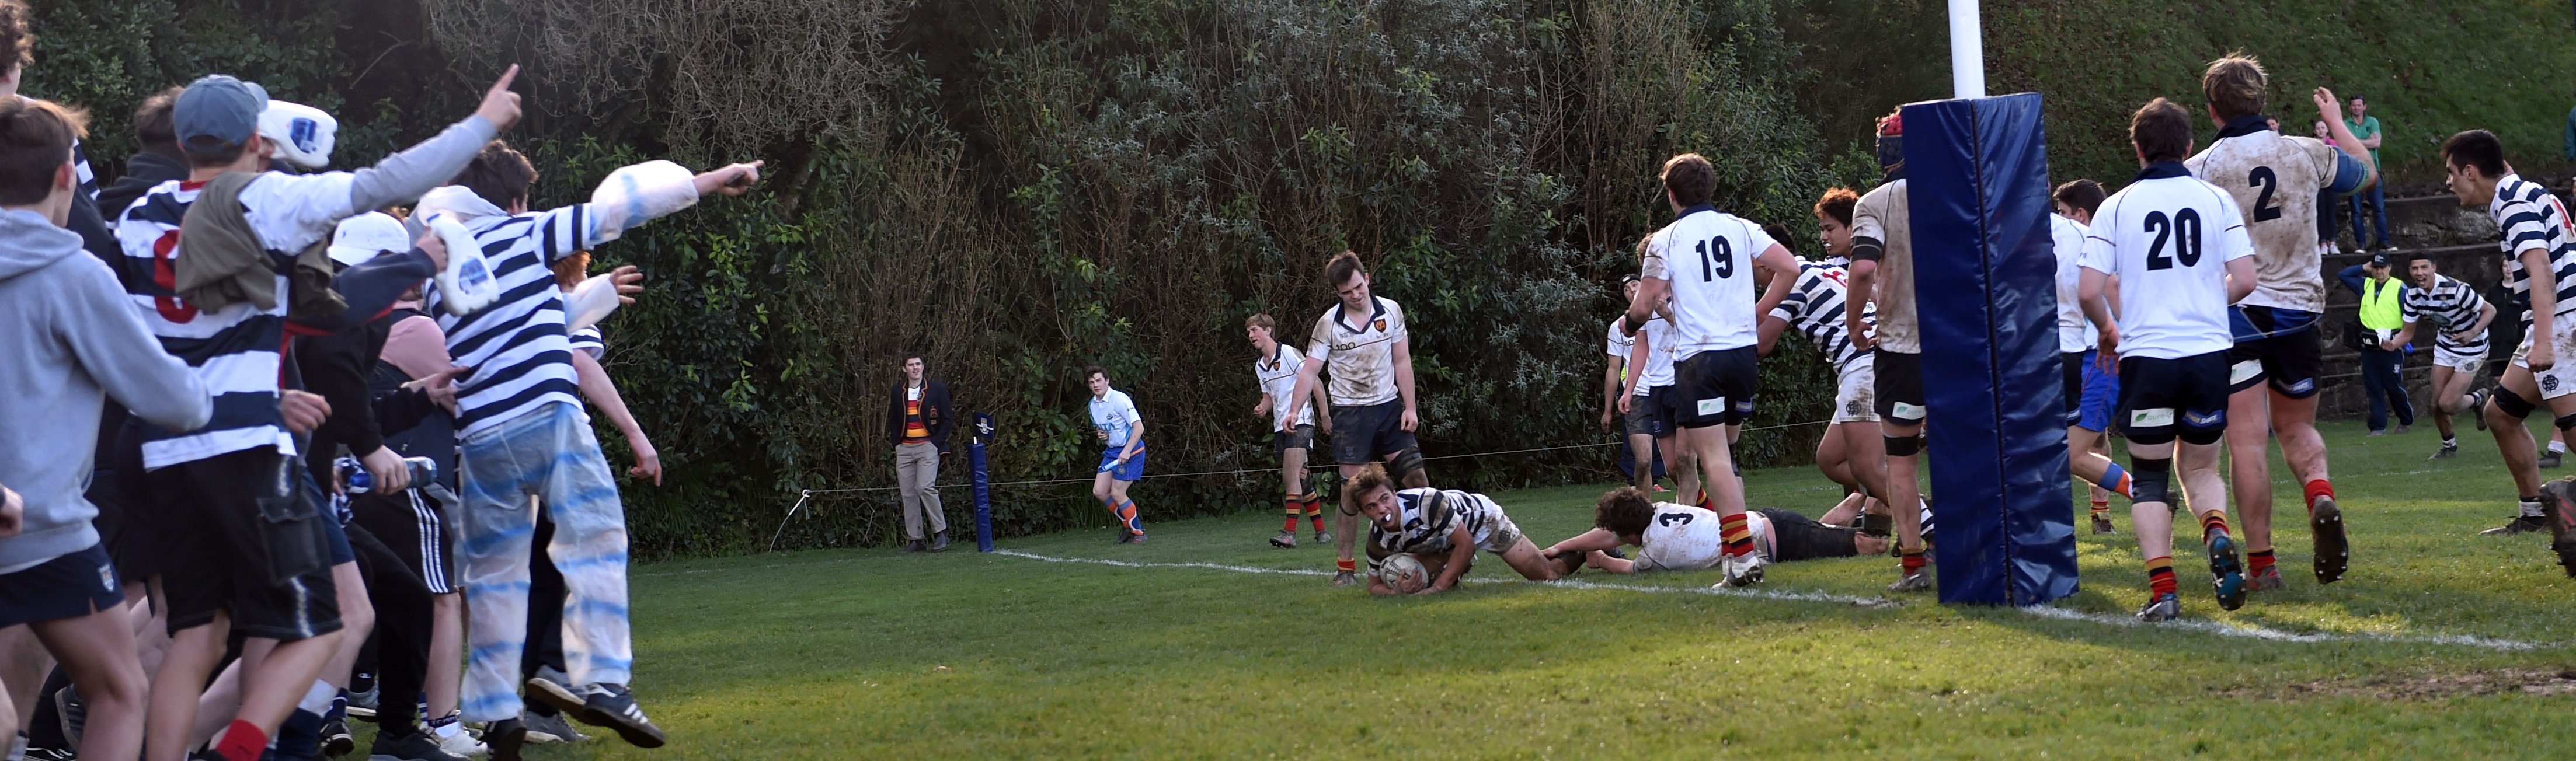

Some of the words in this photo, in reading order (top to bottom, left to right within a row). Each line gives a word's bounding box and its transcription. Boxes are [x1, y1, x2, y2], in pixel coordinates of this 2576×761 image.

[2249, 166, 2281, 222] 2
[1695, 235, 1733, 282] 19
[2144, 207, 2201, 271] 20
[1659, 512, 1694, 528] 3
